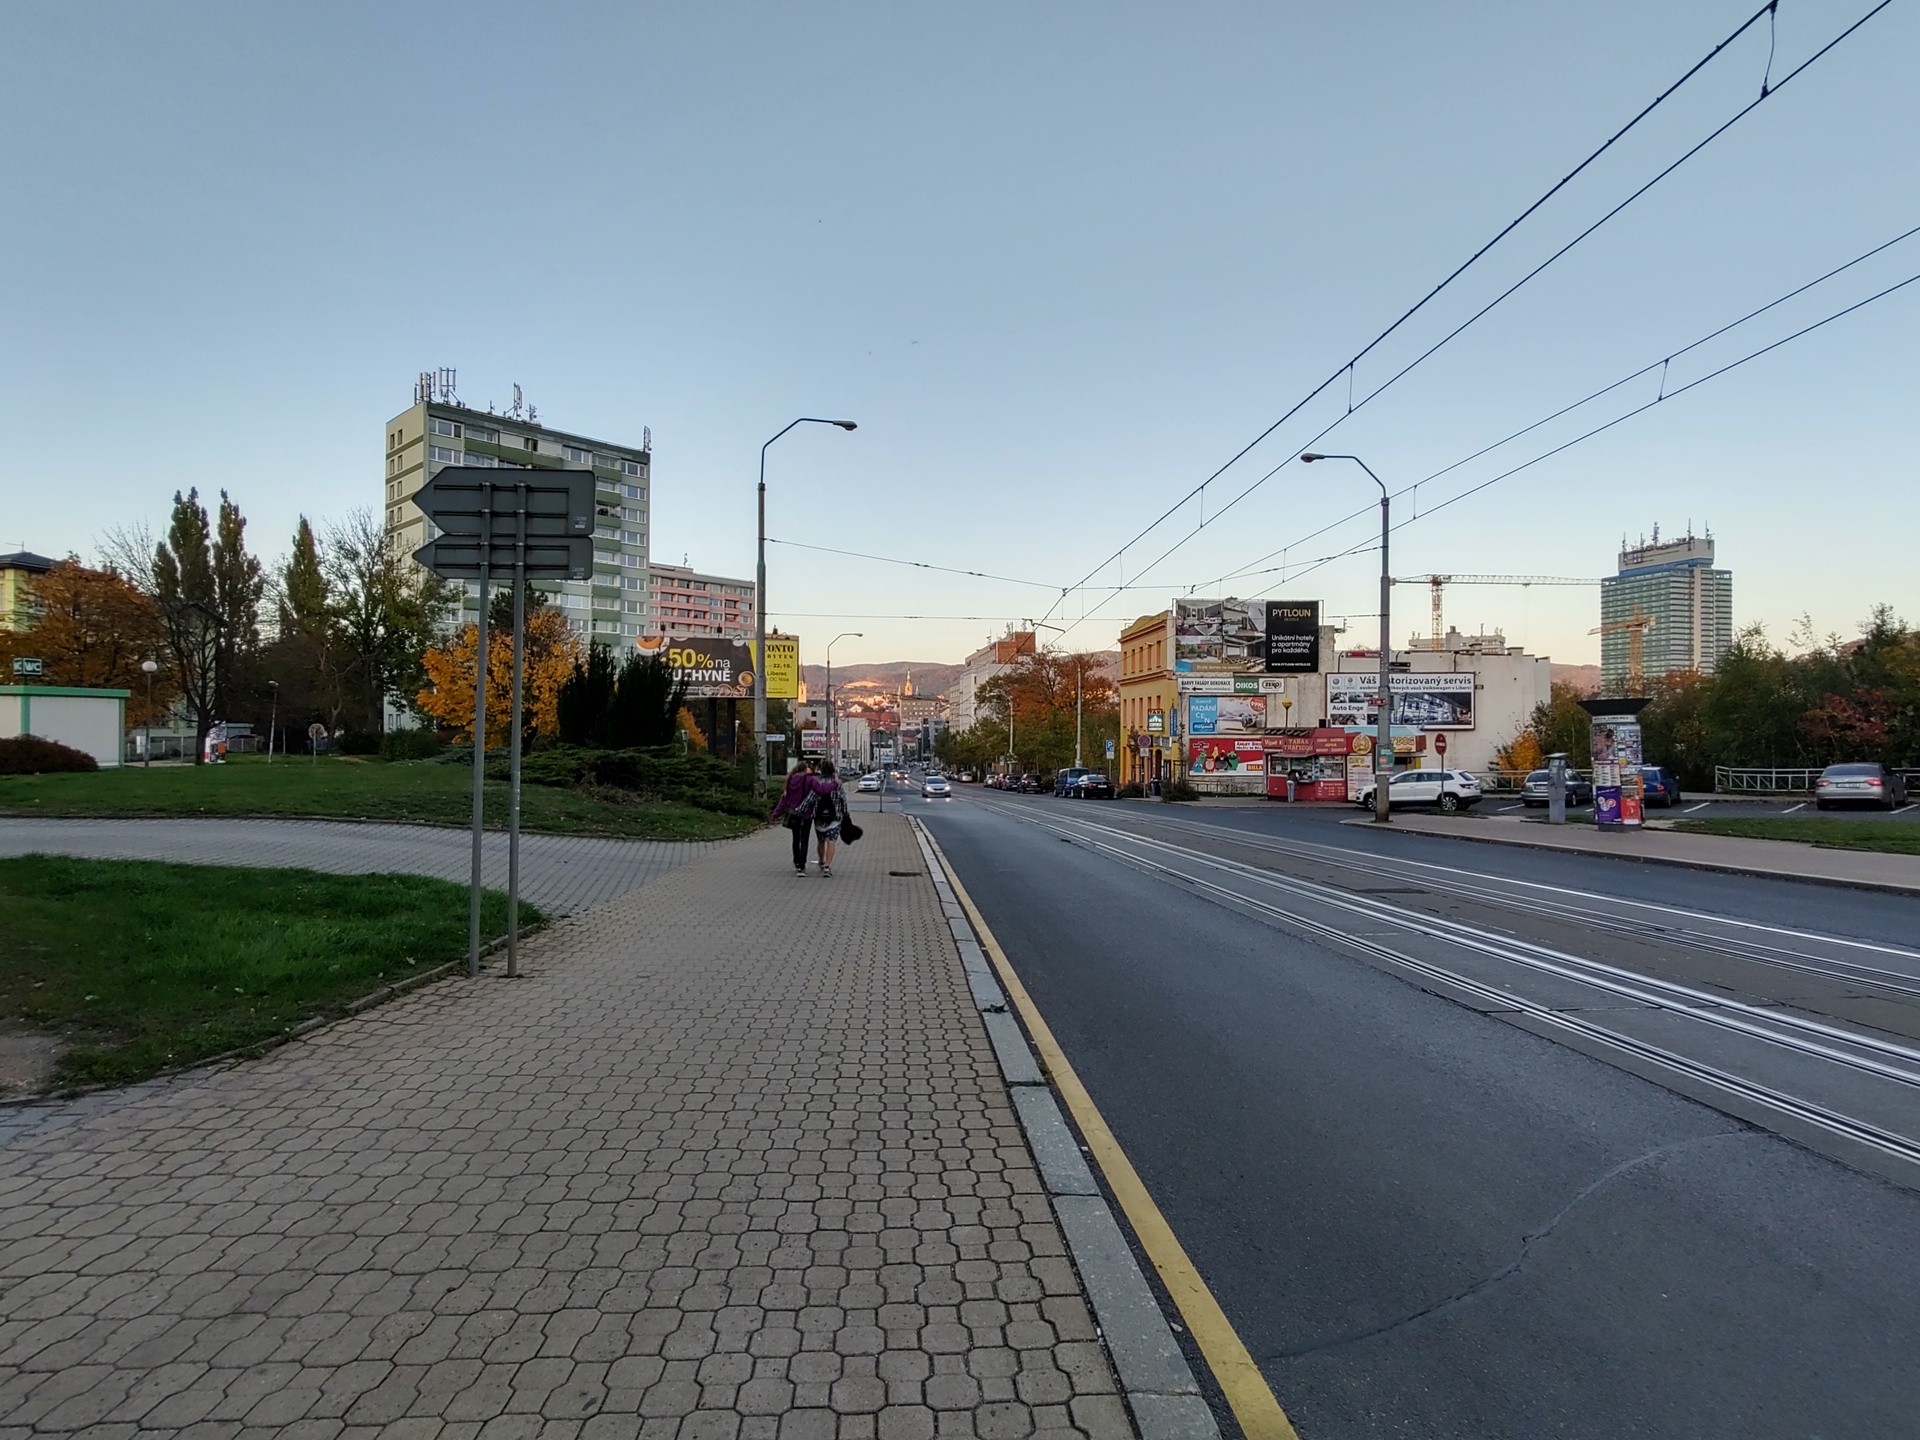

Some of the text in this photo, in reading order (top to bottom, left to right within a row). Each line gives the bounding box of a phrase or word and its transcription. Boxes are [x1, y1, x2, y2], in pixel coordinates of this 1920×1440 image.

[1272, 608, 1312, 617] PYTLOUN
[1296, 634, 1315, 642] hotely
[765, 644, 794, 653] CONTO
[24, 662, 41, 671] WC
[715, 658, 731, 668] na
[1359, 676, 1472, 687] Váš torizovaný servis
[1191, 704, 1217, 712] PADÁNÍ
